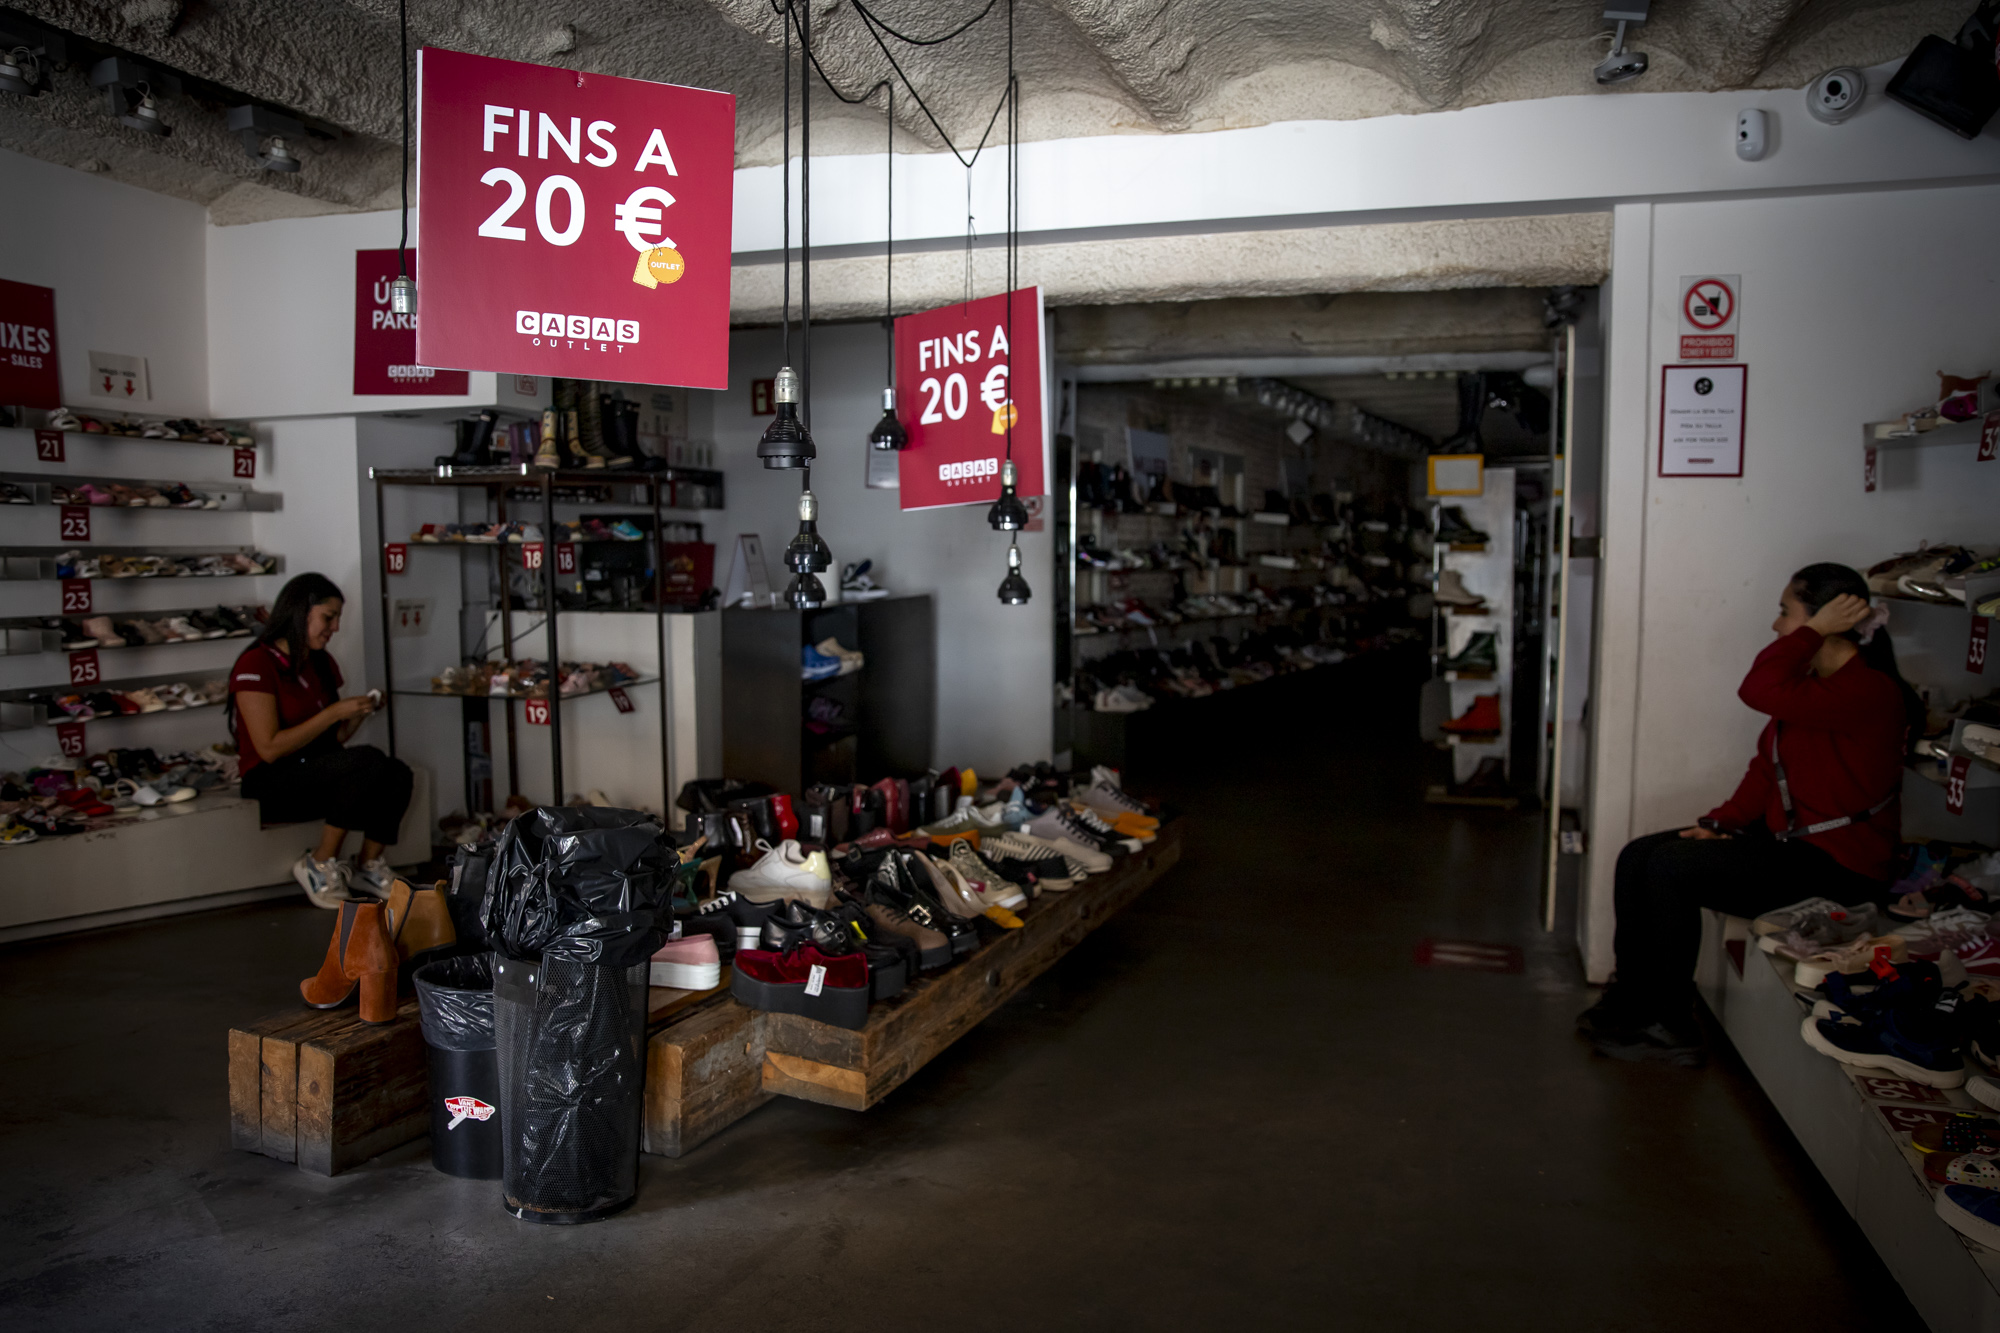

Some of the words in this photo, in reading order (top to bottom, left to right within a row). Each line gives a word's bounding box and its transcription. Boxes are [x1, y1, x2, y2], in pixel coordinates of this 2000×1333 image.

[483, 104, 618, 168] FINS
[634, 128, 678, 177] A
[478, 167, 586, 246] 20
[615, 186, 678, 254] €
[650, 261, 681, 271] OUTLET
[518, 312, 637, 341] CASAS
[532, 338, 625, 353] OUTLET
[919, 330, 982, 372] FINS
[988, 324, 1009, 359] A
[1682, 337, 1733, 347] PROHIBIDO
[11, 353, 43, 369] SALES
[919, 372, 969, 426] 20
[980, 364, 1013, 413] €
[38, 438, 61, 459] 21
[235, 457, 254, 475] 21
[940, 459, 997, 479] CASAS
[947, 476, 991, 487] OUTLET
[62, 518, 89, 537] 23
[388, 553, 404, 571] 18
[524, 550, 542, 569] 18
[558, 552, 574, 571] 18
[64, 591, 90, 611] 23
[1968, 636, 1986, 666] 33
[71, 661, 97, 683] 25
[527, 705, 548, 724] 19
[61, 734, 83, 755] 25
[1946, 776, 1965, 809] 33
[458, 1098, 476, 1107] VANS
